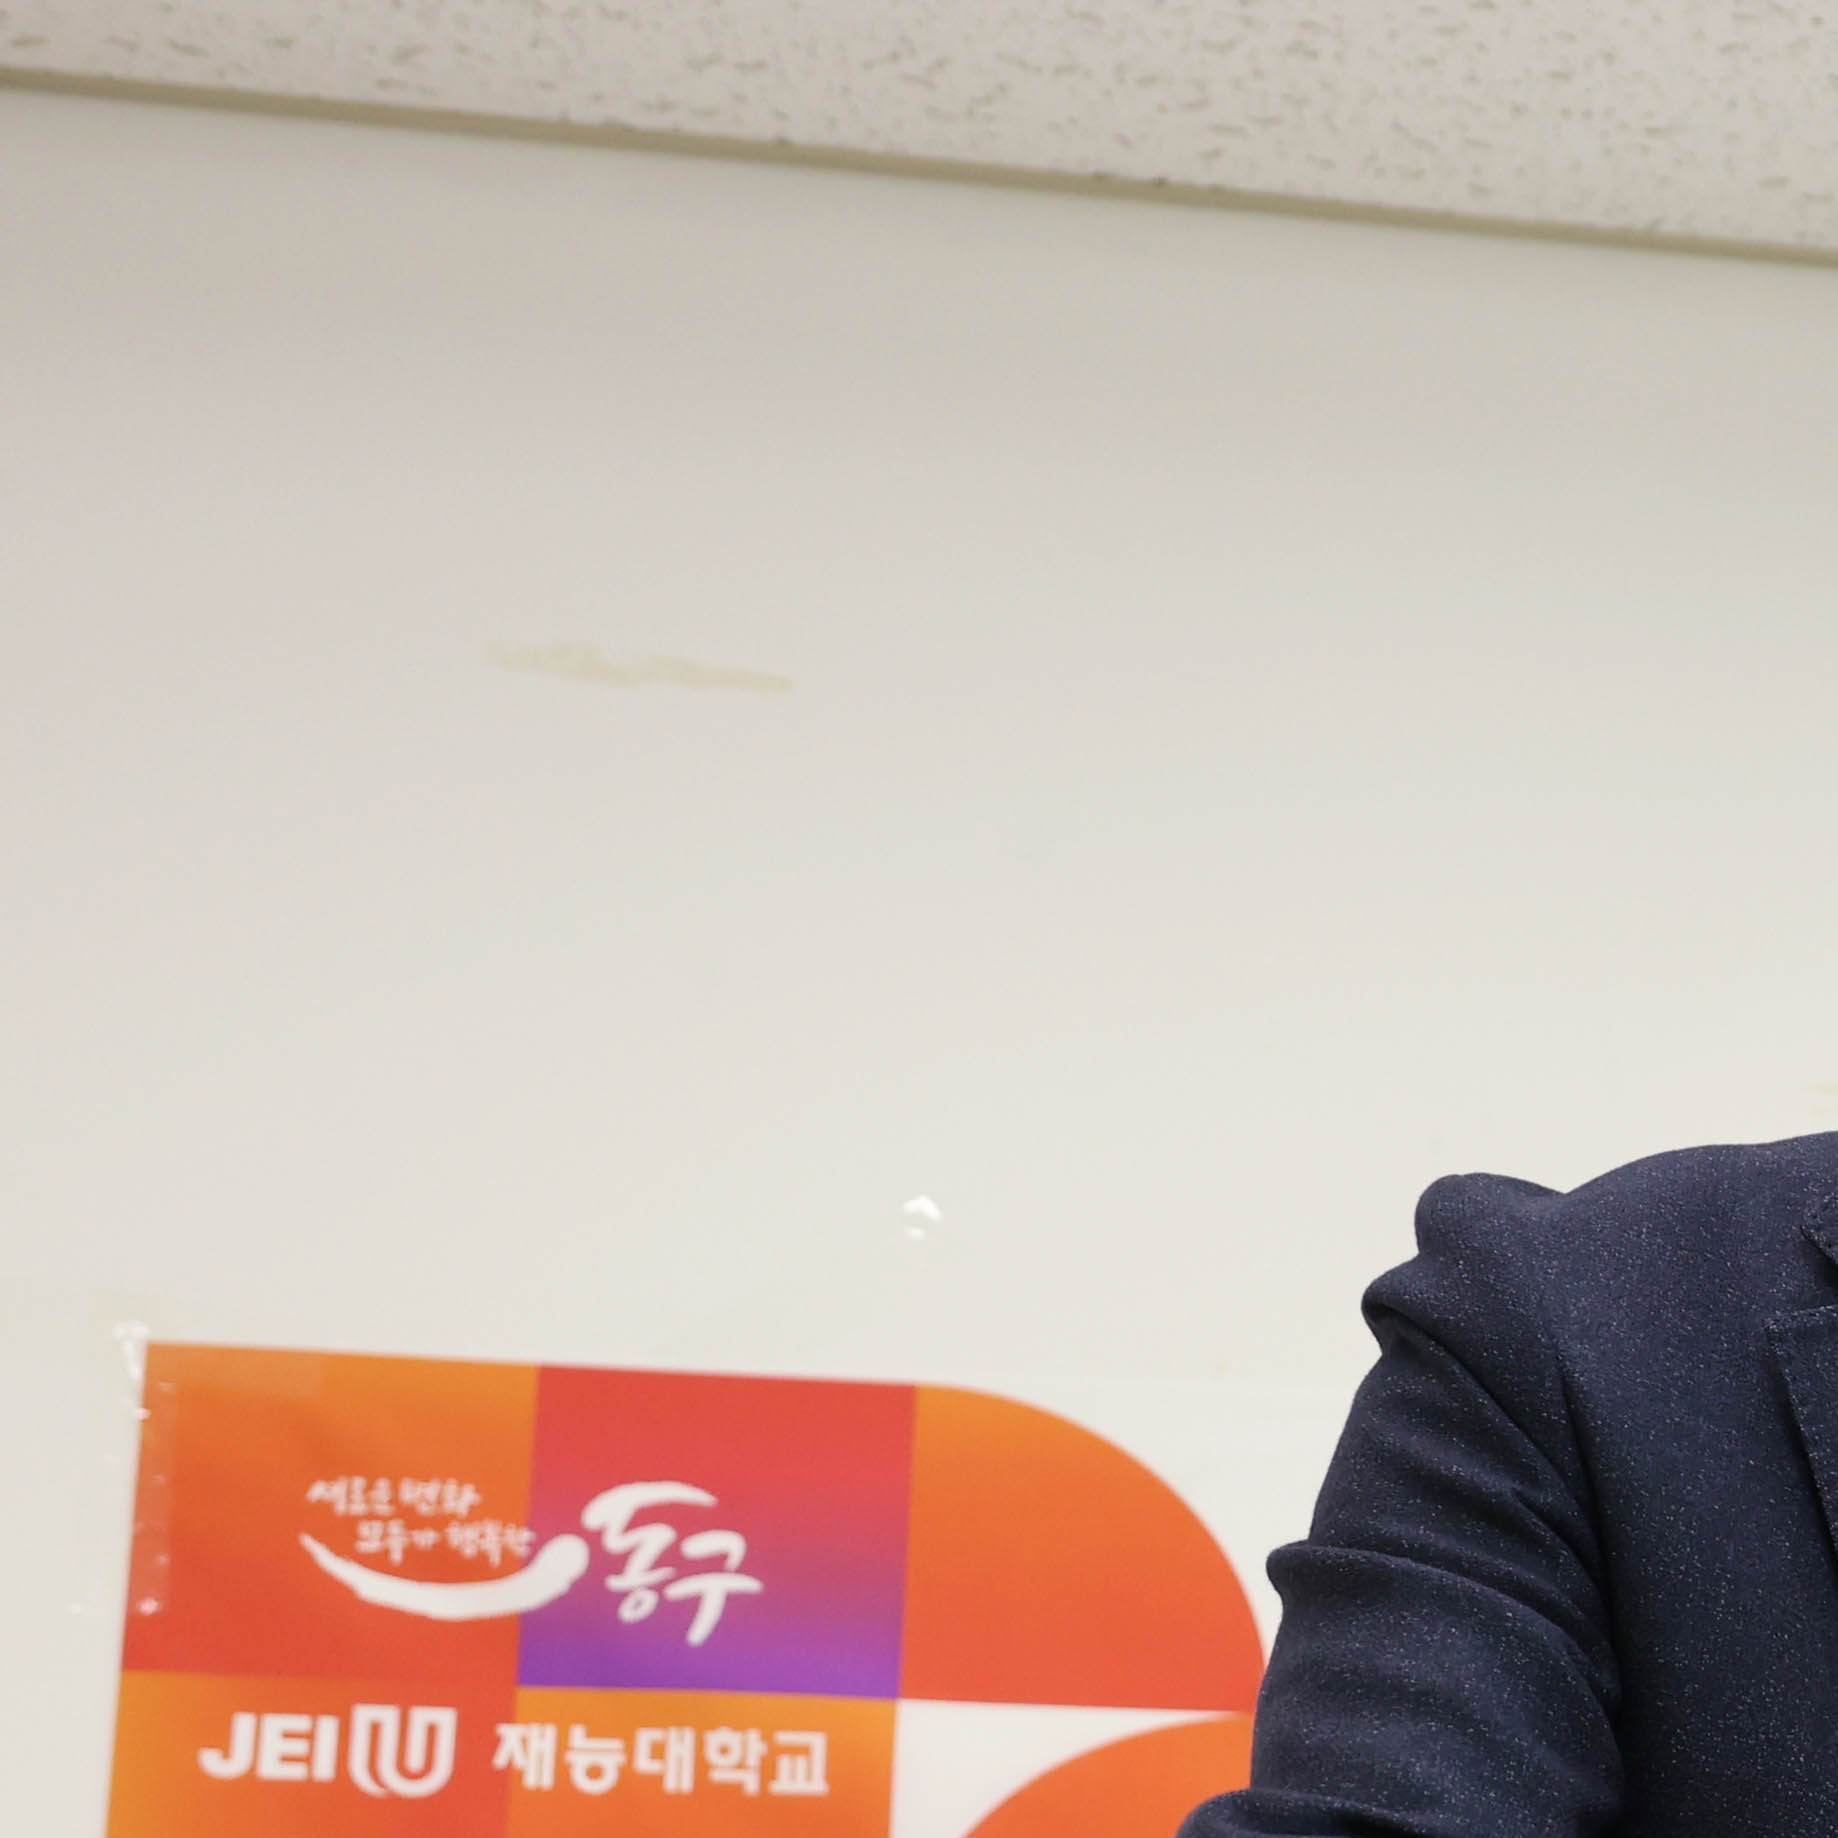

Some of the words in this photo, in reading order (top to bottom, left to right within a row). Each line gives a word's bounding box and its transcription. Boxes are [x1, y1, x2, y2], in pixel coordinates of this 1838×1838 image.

[400, 1477, 482, 1518] 변화
[581, 1480, 763, 1647] 동구
[492, 1722, 830, 1794] 재능대학교
